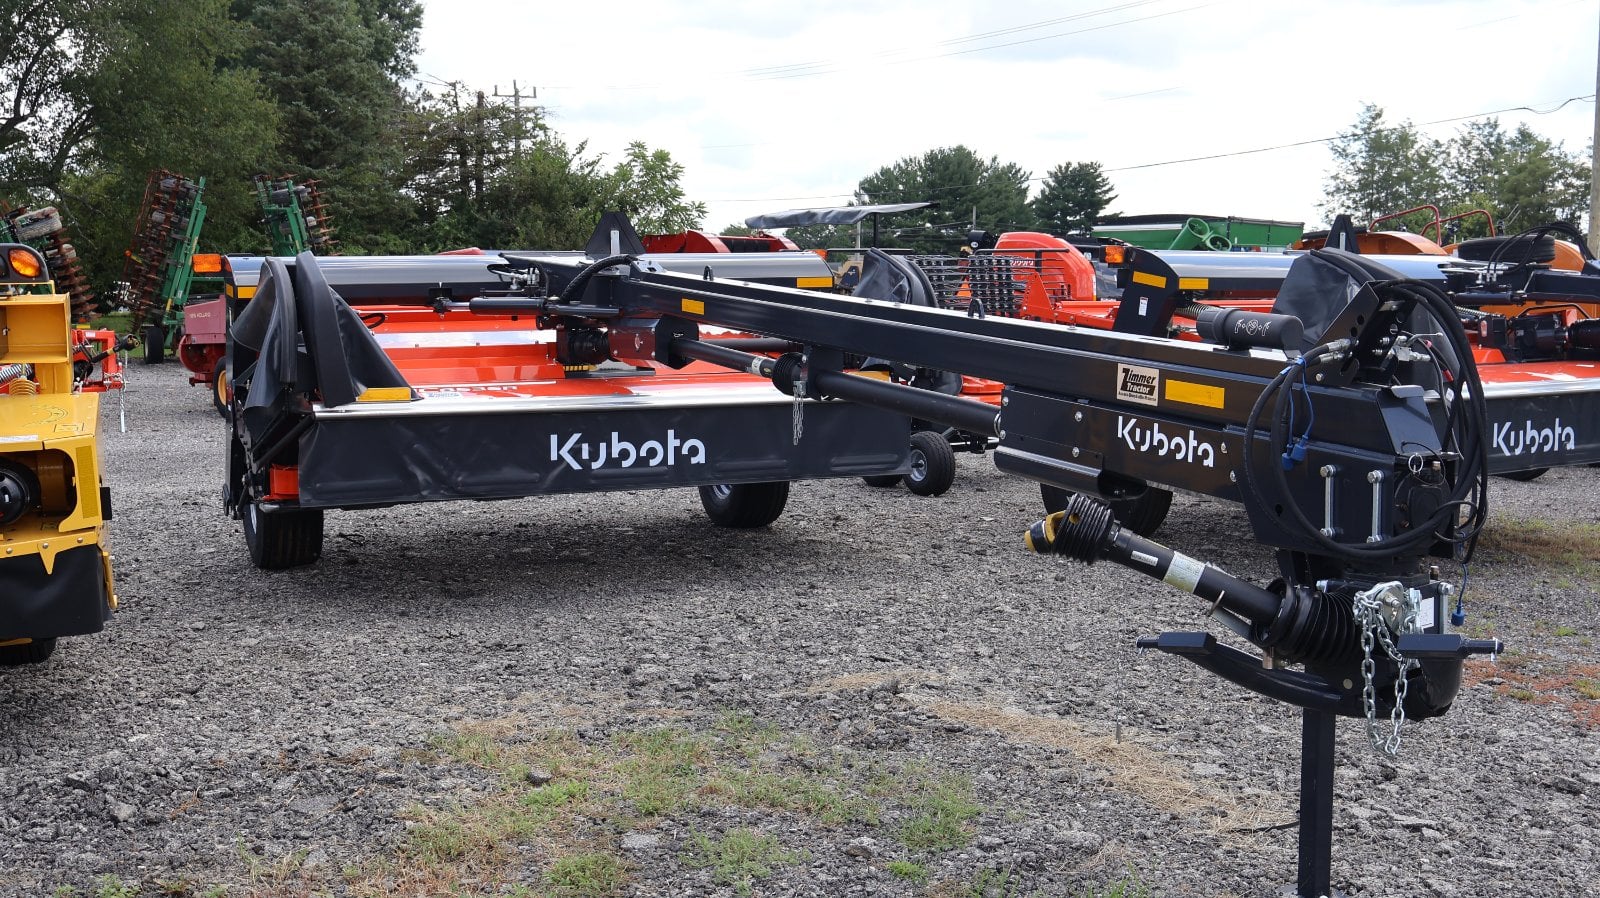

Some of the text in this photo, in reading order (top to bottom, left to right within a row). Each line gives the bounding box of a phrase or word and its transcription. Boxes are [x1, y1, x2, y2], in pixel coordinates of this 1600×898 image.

[1121, 367, 1157, 387] Zimmer
[1126, 382, 1151, 394] Tractor
[550, 429, 706, 470] Kubota
[1117, 415, 1214, 468] Kubota
[1492, 418, 1575, 456] Kubota
